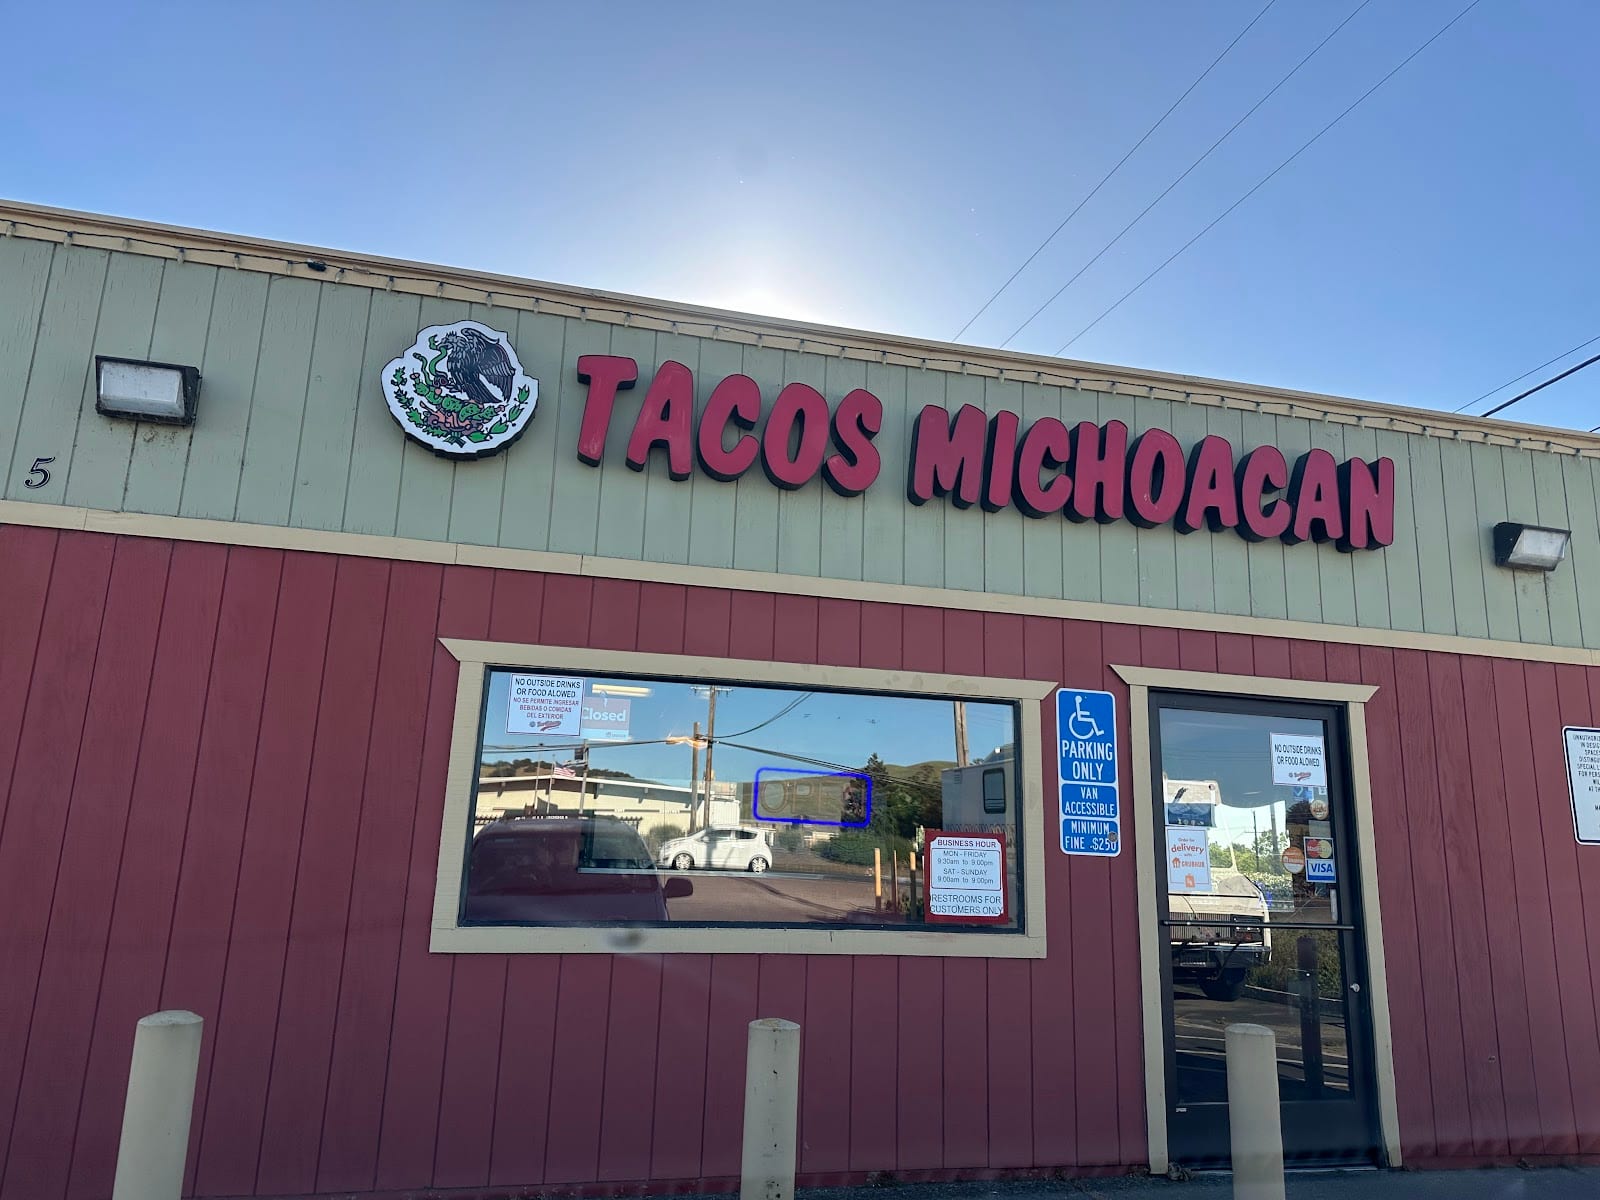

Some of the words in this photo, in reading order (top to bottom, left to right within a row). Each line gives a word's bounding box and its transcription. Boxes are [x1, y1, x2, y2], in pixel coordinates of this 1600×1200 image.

[577, 355, 883, 497] TACOS
[907, 403, 1394, 553] MICHOACAN
[23, 456, 55, 489] 5
[527, 679, 555, 687] OUTSIDE
[582, 707, 626, 721] Closed
[1062, 739, 1113, 761] PARKING
[1274, 744, 1282, 752] NO
[1282, 744, 1303, 754] OUTSIDE
[1304, 746, 1322, 755] DRINKS
[1276, 756, 1284, 764] OR
[1285, 756, 1298, 765] FOOD
[1072, 761, 1104, 780] ONLY
[1080, 786, 1098, 800] VAN
[1065, 801, 1115, 816] ACCESSIBLE
[1071, 820, 1110, 834] MINIMUM
[976, 840, 996, 848] HOUR
[1065, 836, 1085, 850] FINE
[1171, 844, 1204, 854] delivery
[960, 868, 988, 876] SUNDAY
[1310, 863, 1333, 872] VISA
[932, 894, 983, 904] RESTROOMS
[984, 896, 1000, 904] FOR
[931, 904, 980, 914] CUSTOMERS
[982, 906, 1003, 914] ONLY
